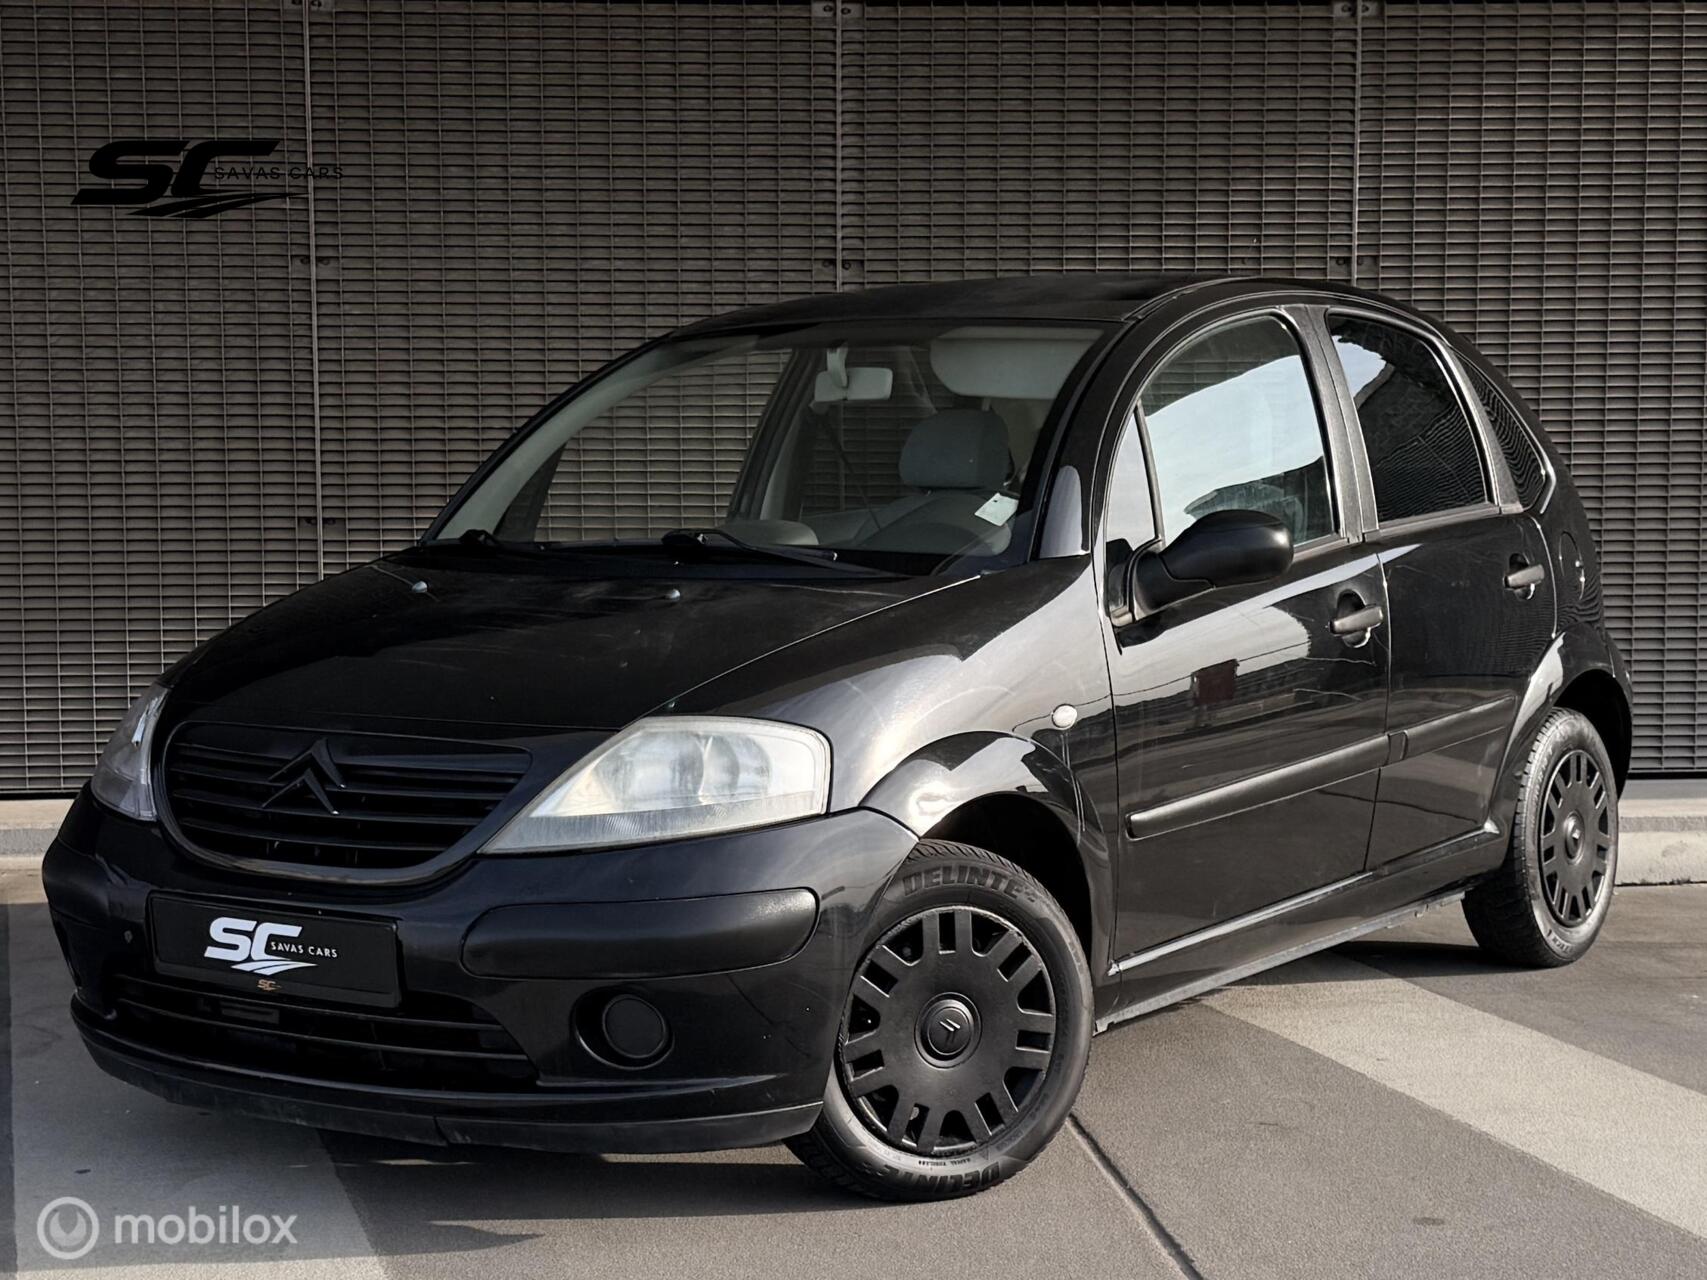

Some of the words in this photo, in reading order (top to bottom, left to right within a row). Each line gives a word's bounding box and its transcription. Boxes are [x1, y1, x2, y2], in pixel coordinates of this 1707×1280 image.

[903, 865, 1025, 899] DELINTE
[204, 917, 302, 962] SC
[270, 941, 304, 954] SAVAS
[308, 945, 338, 958] CARS
